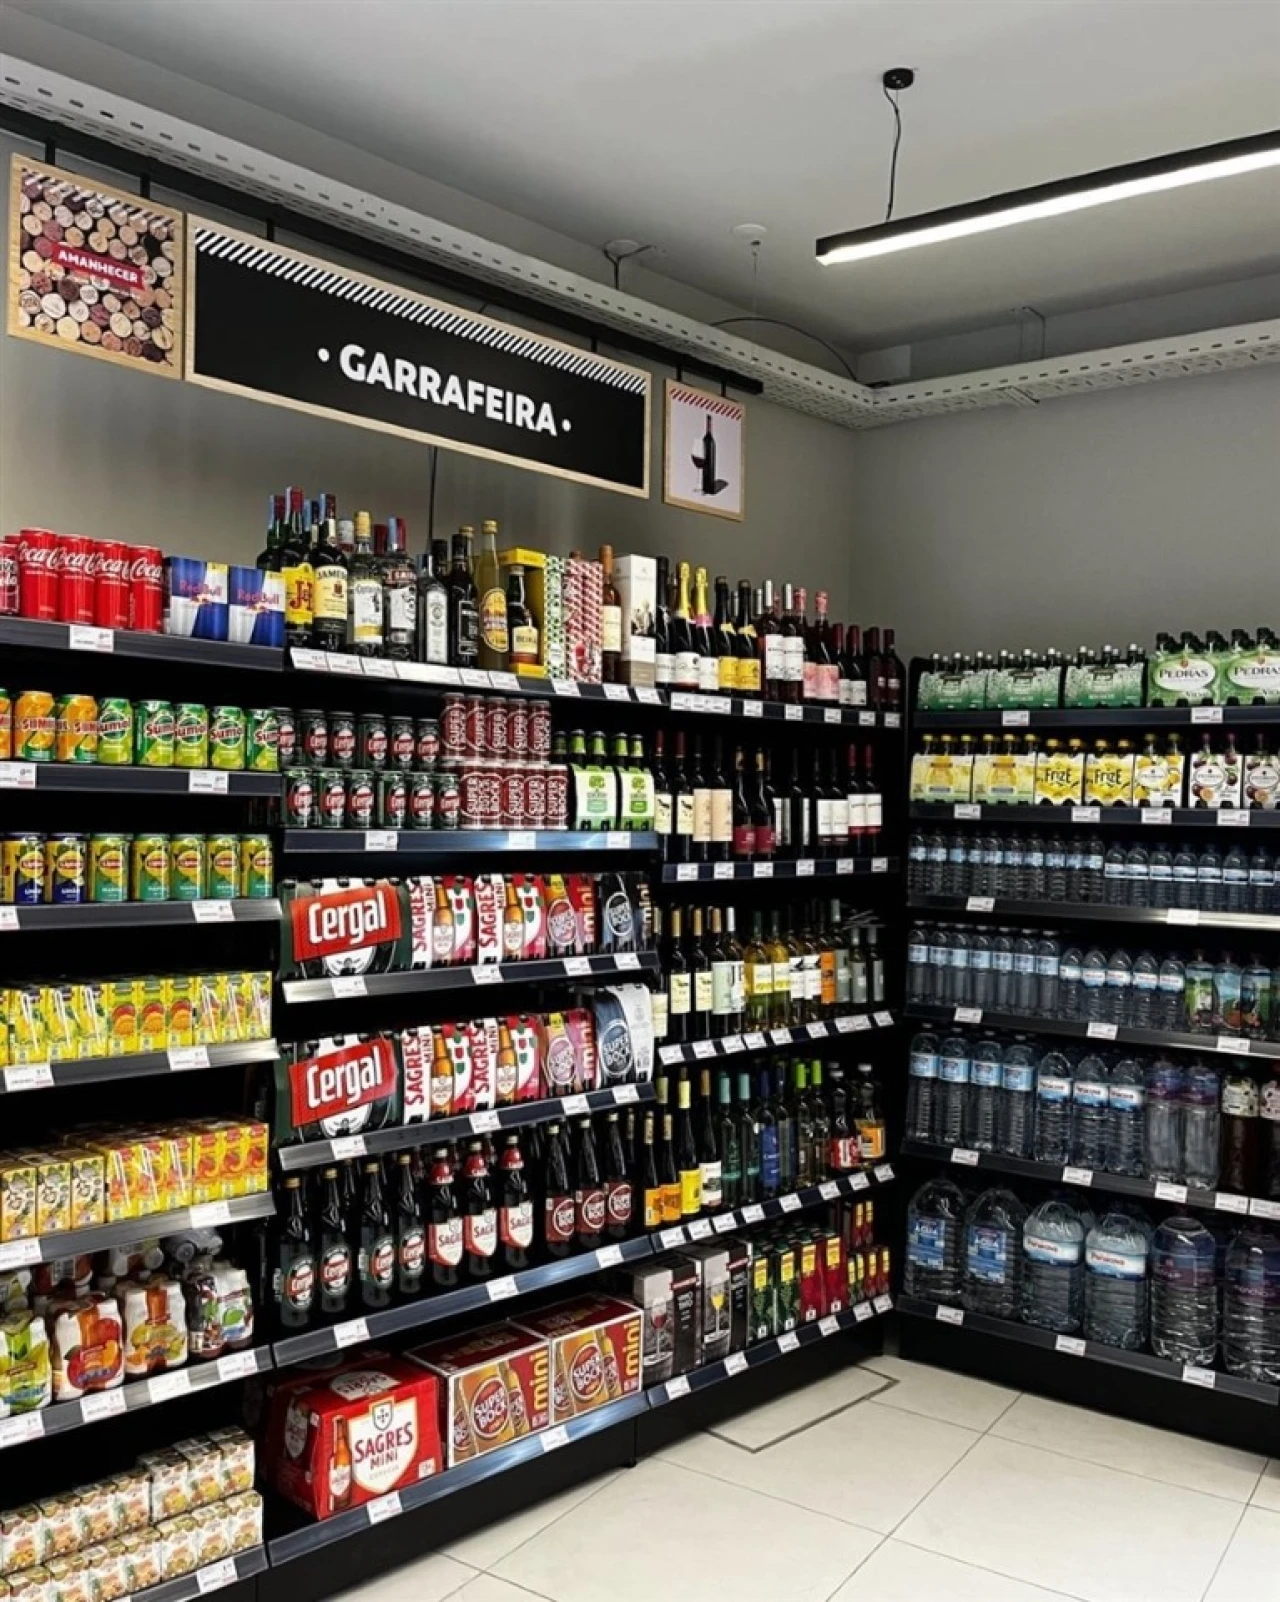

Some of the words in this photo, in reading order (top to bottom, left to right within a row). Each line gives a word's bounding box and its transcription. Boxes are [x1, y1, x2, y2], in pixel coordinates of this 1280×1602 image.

[58, 249, 138, 283] AMANHECER
[339, 343, 558, 437] GARRAFEIRA
[1159, 668, 1209, 679] PEDRAS
[424, 882, 435, 911] MINI
[479, 881, 498, 947] SAGRES
[493, 881, 505, 909] MINI
[308, 890, 387, 945] Cergal
[410, 882, 427, 951] SAGRES
[420, 1033, 432, 1063] MINI
[472, 1027, 490, 1094] SAGRES
[307, 1045, 383, 1109] Cergal
[404, 1034, 424, 1105] SAGRES
[573, 1353, 601, 1378] SUPER
[623, 1320, 640, 1376] mini
[529, 1351, 549, 1412] mini
[576, 1366, 602, 1391] BOCK
[475, 1386, 506, 1418] SUPER
[479, 1400, 507, 1429] BOCK
[354, 1421, 413, 1464] SAGRES
[370, 1449, 398, 1470] MINI
